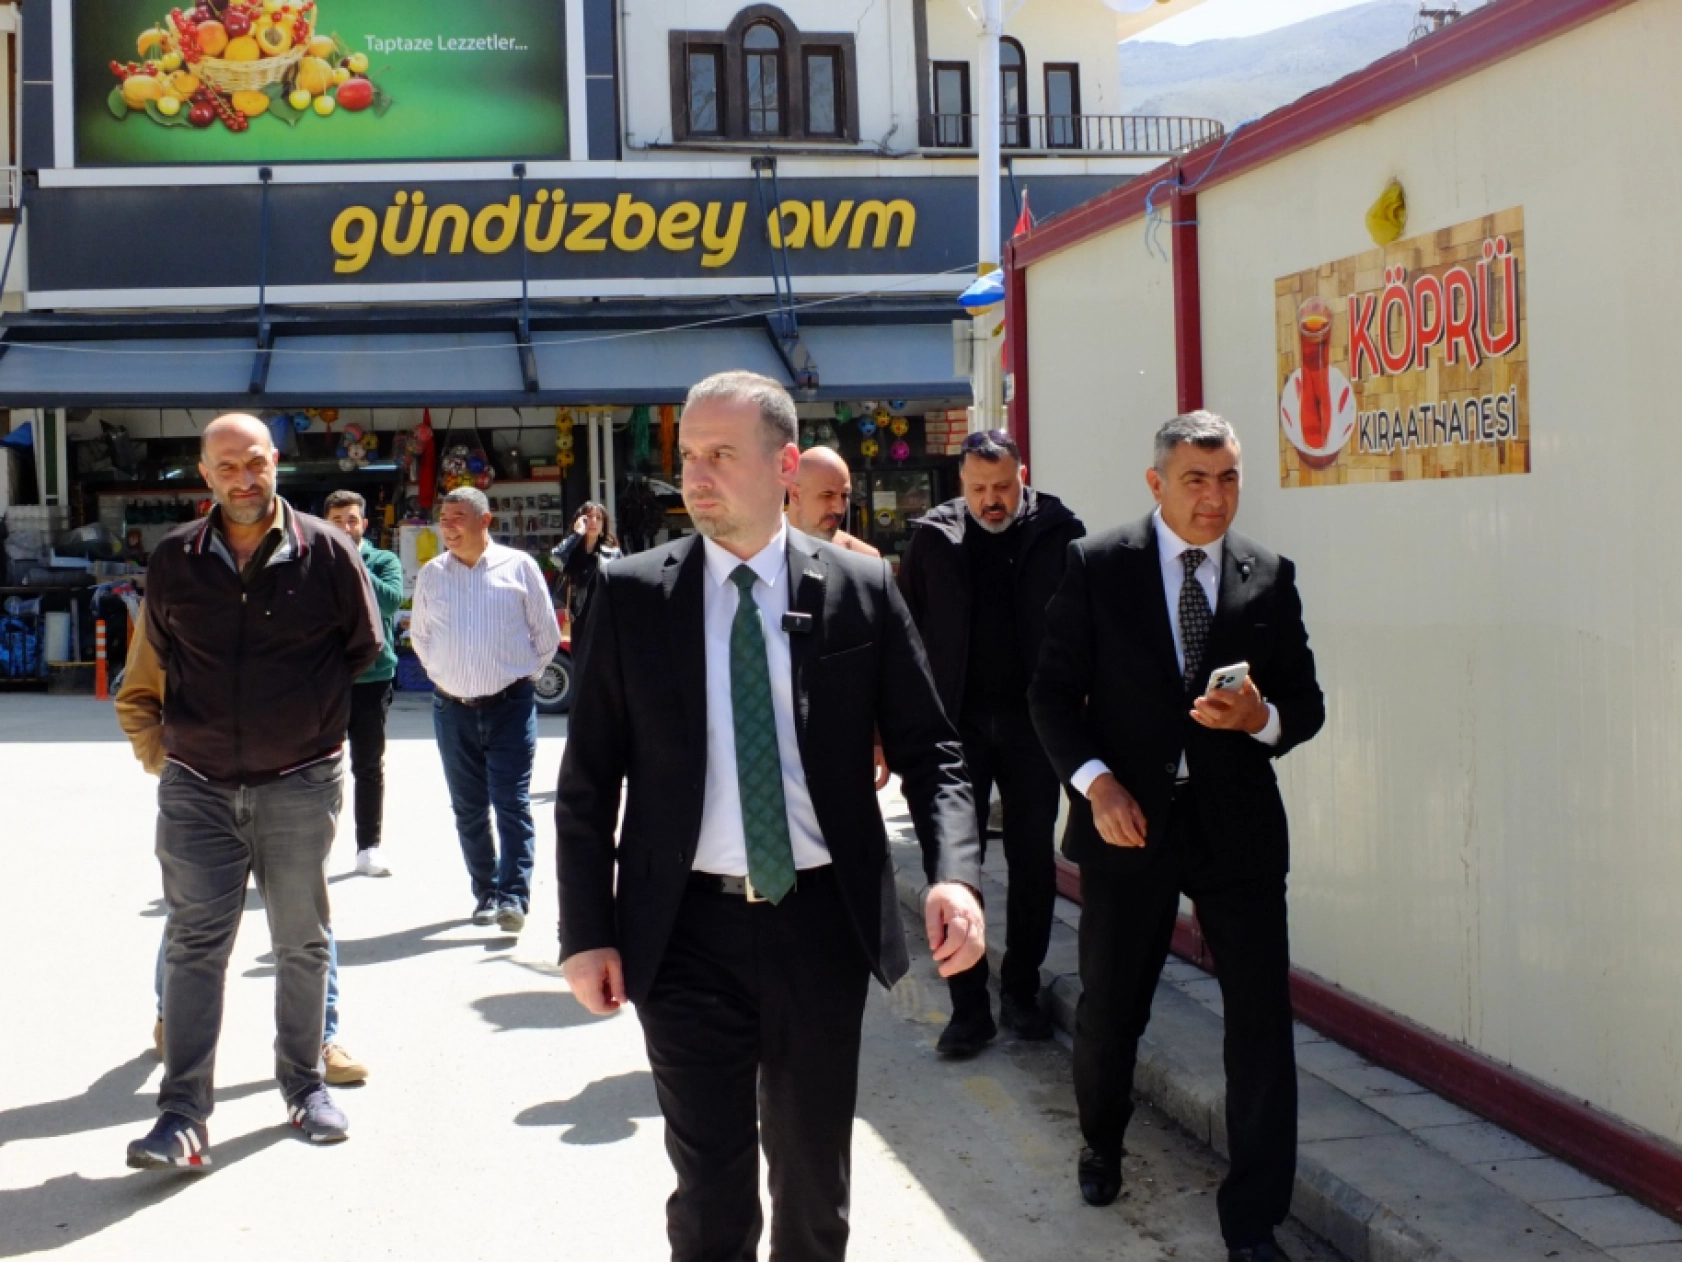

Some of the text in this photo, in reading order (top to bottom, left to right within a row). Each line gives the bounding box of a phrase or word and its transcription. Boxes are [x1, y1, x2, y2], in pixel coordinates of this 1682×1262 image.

[364, 34, 528, 55] Taptaze Lezzetler...
[330, 188, 916, 273] gündüzbey avm
[1348, 235, 1520, 381] KÖPRÜ
